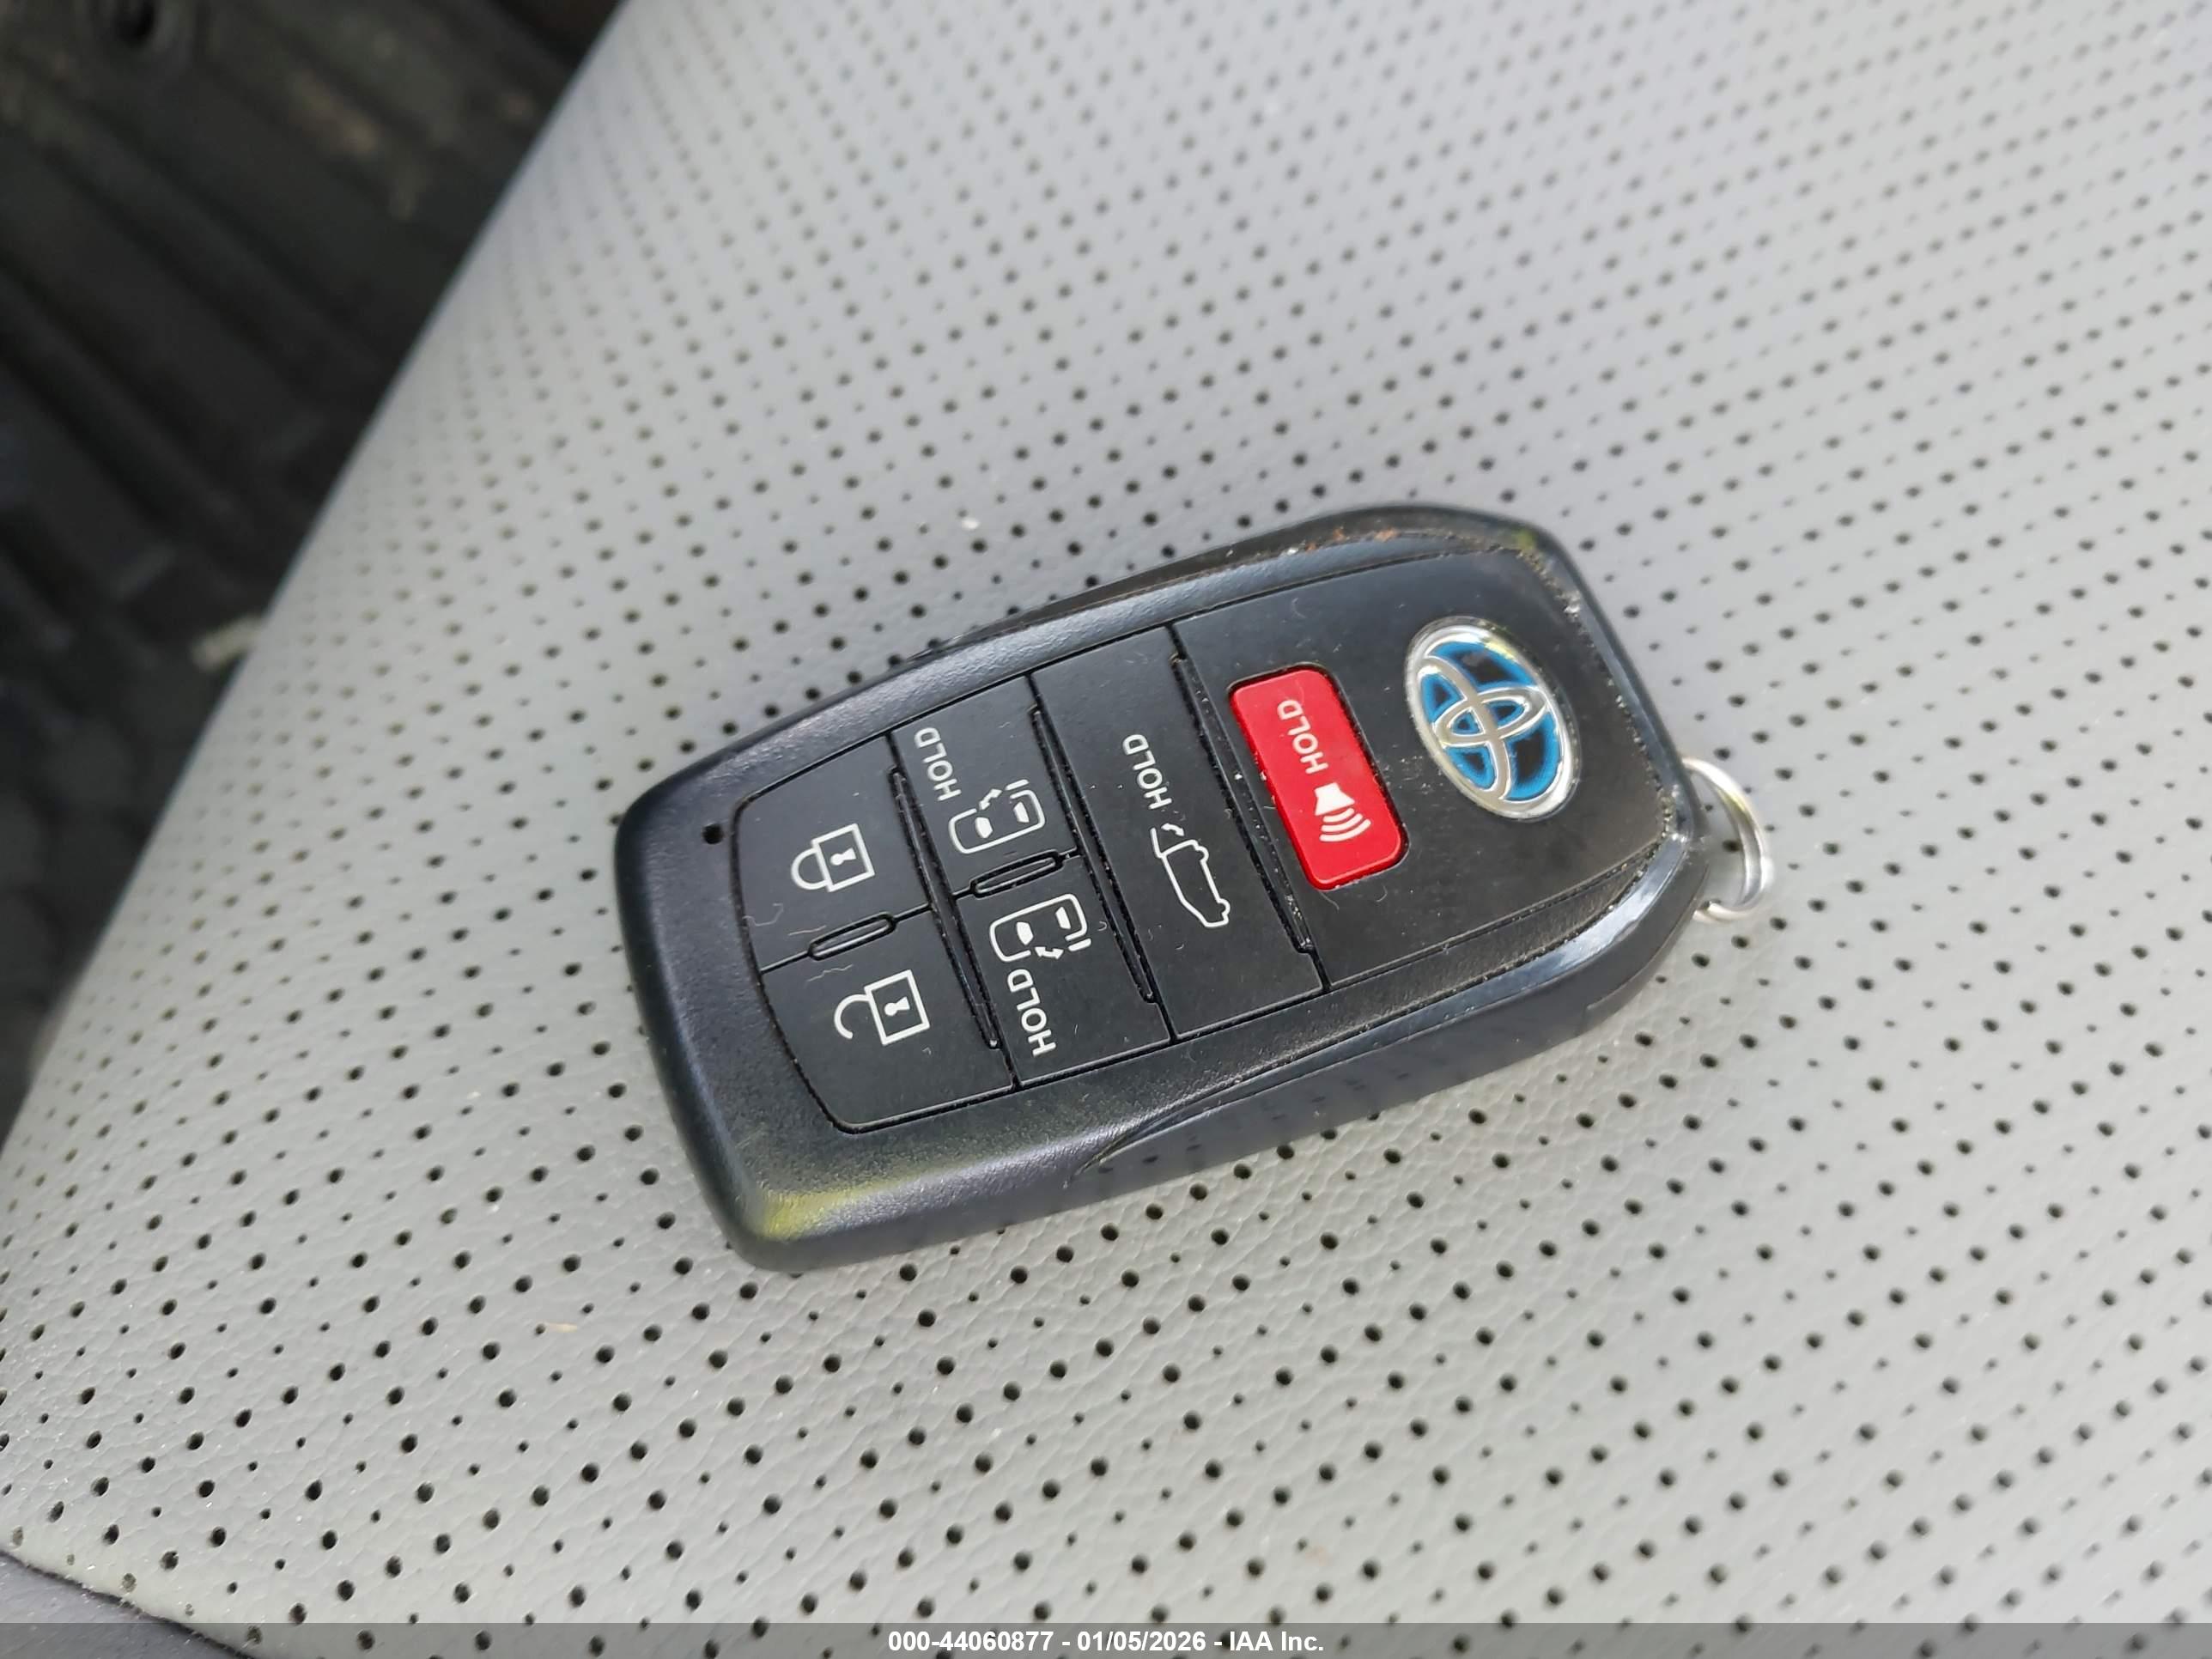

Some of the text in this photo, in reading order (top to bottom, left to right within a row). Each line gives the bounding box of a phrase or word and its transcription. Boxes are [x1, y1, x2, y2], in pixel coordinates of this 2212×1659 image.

[914, 726, 962, 801] HOLD
[1122, 733, 1172, 810] HOLD
[1277, 699, 1328, 774] HOLD
[1007, 969, 1056, 1056] HOLD
